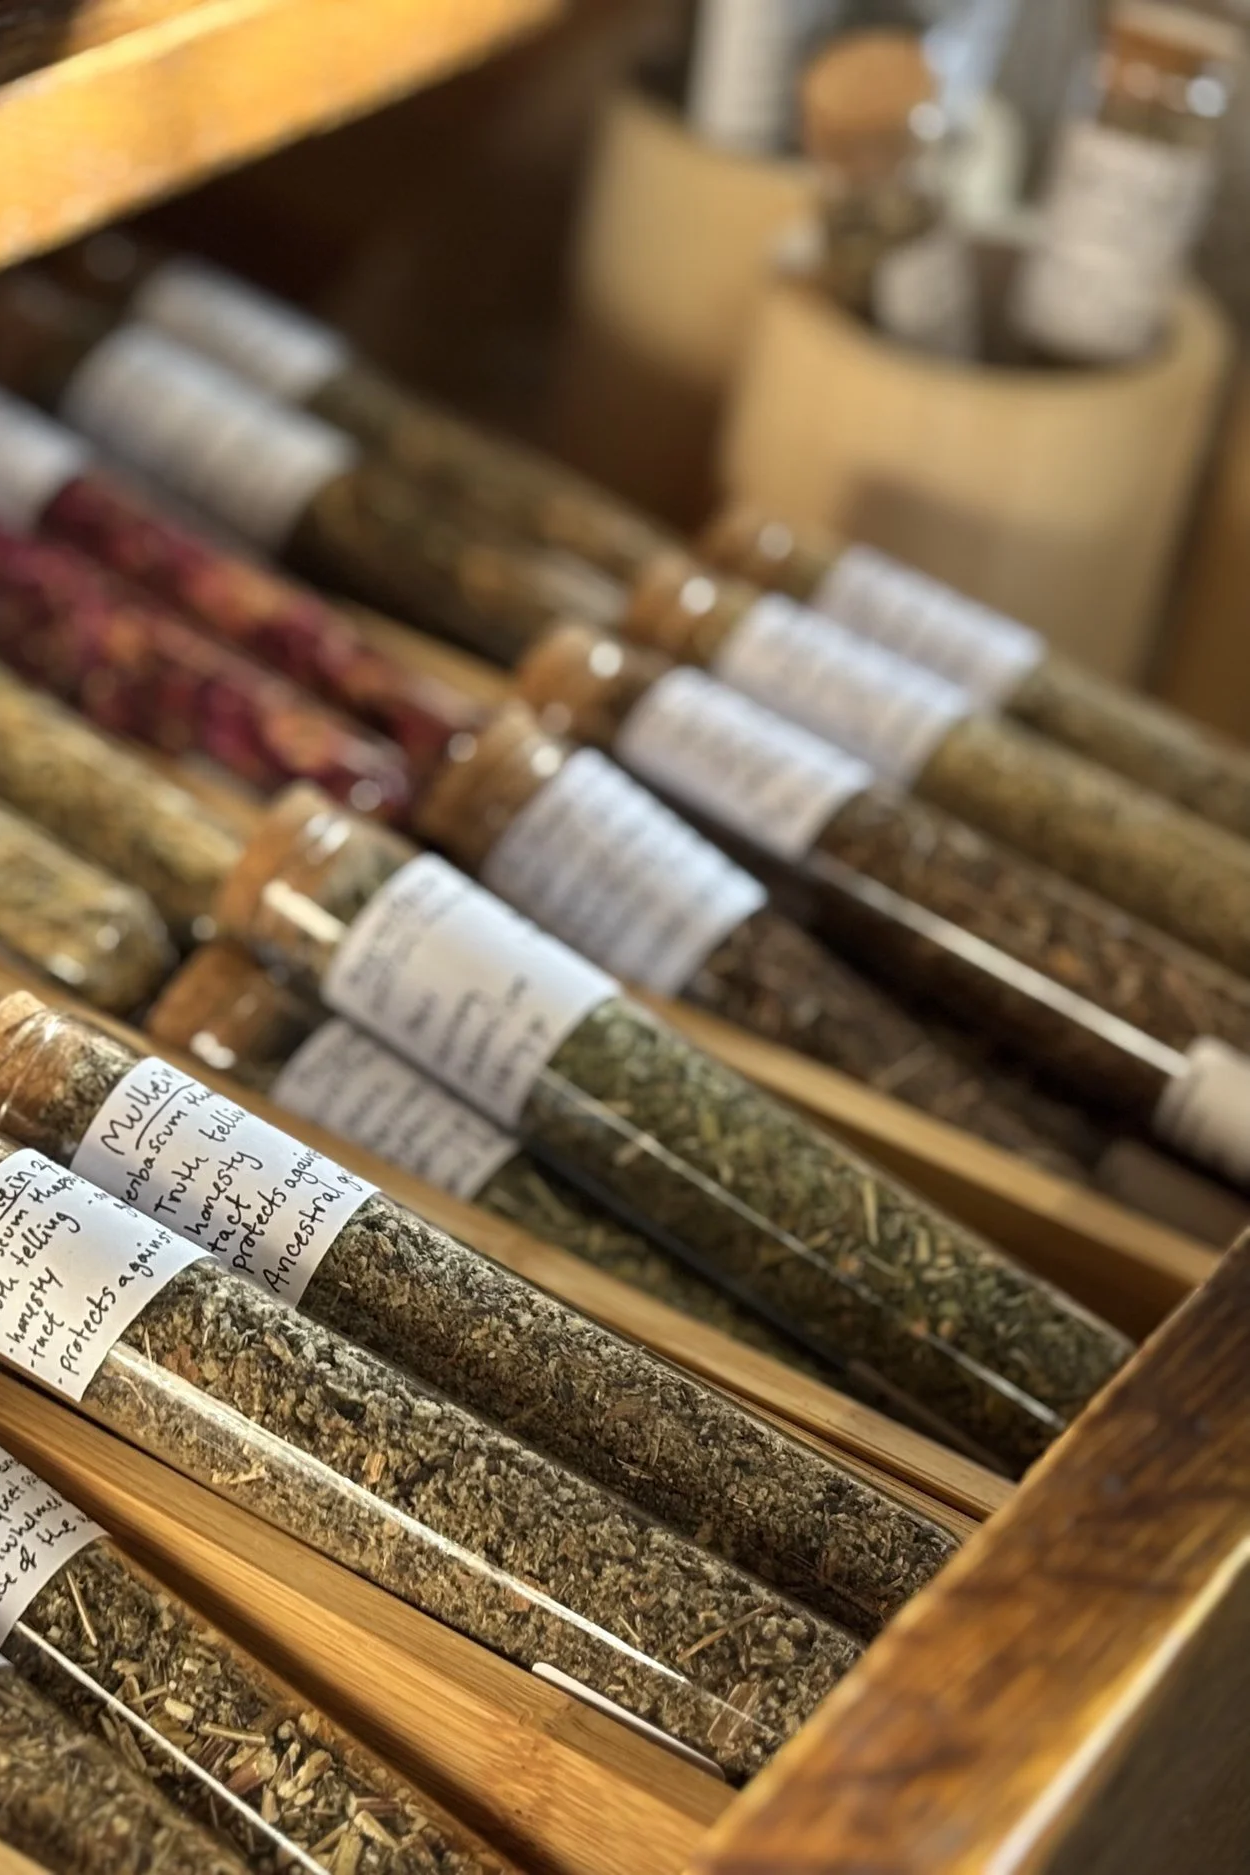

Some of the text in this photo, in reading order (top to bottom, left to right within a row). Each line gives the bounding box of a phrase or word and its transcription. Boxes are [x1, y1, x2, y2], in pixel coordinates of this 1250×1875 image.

[154, 1156, 209, 1215] Truth
[184, 1150, 263, 1236] honesty
[15, 1209, 81, 1269] telling
[207, 1193, 252, 1253] tact
[263, 1180, 346, 1293] Ancestral
[6, 1266, 64, 1345] honesty
[60, 1286, 116, 1375] protects
[36, 1517, 78, 1547] the
